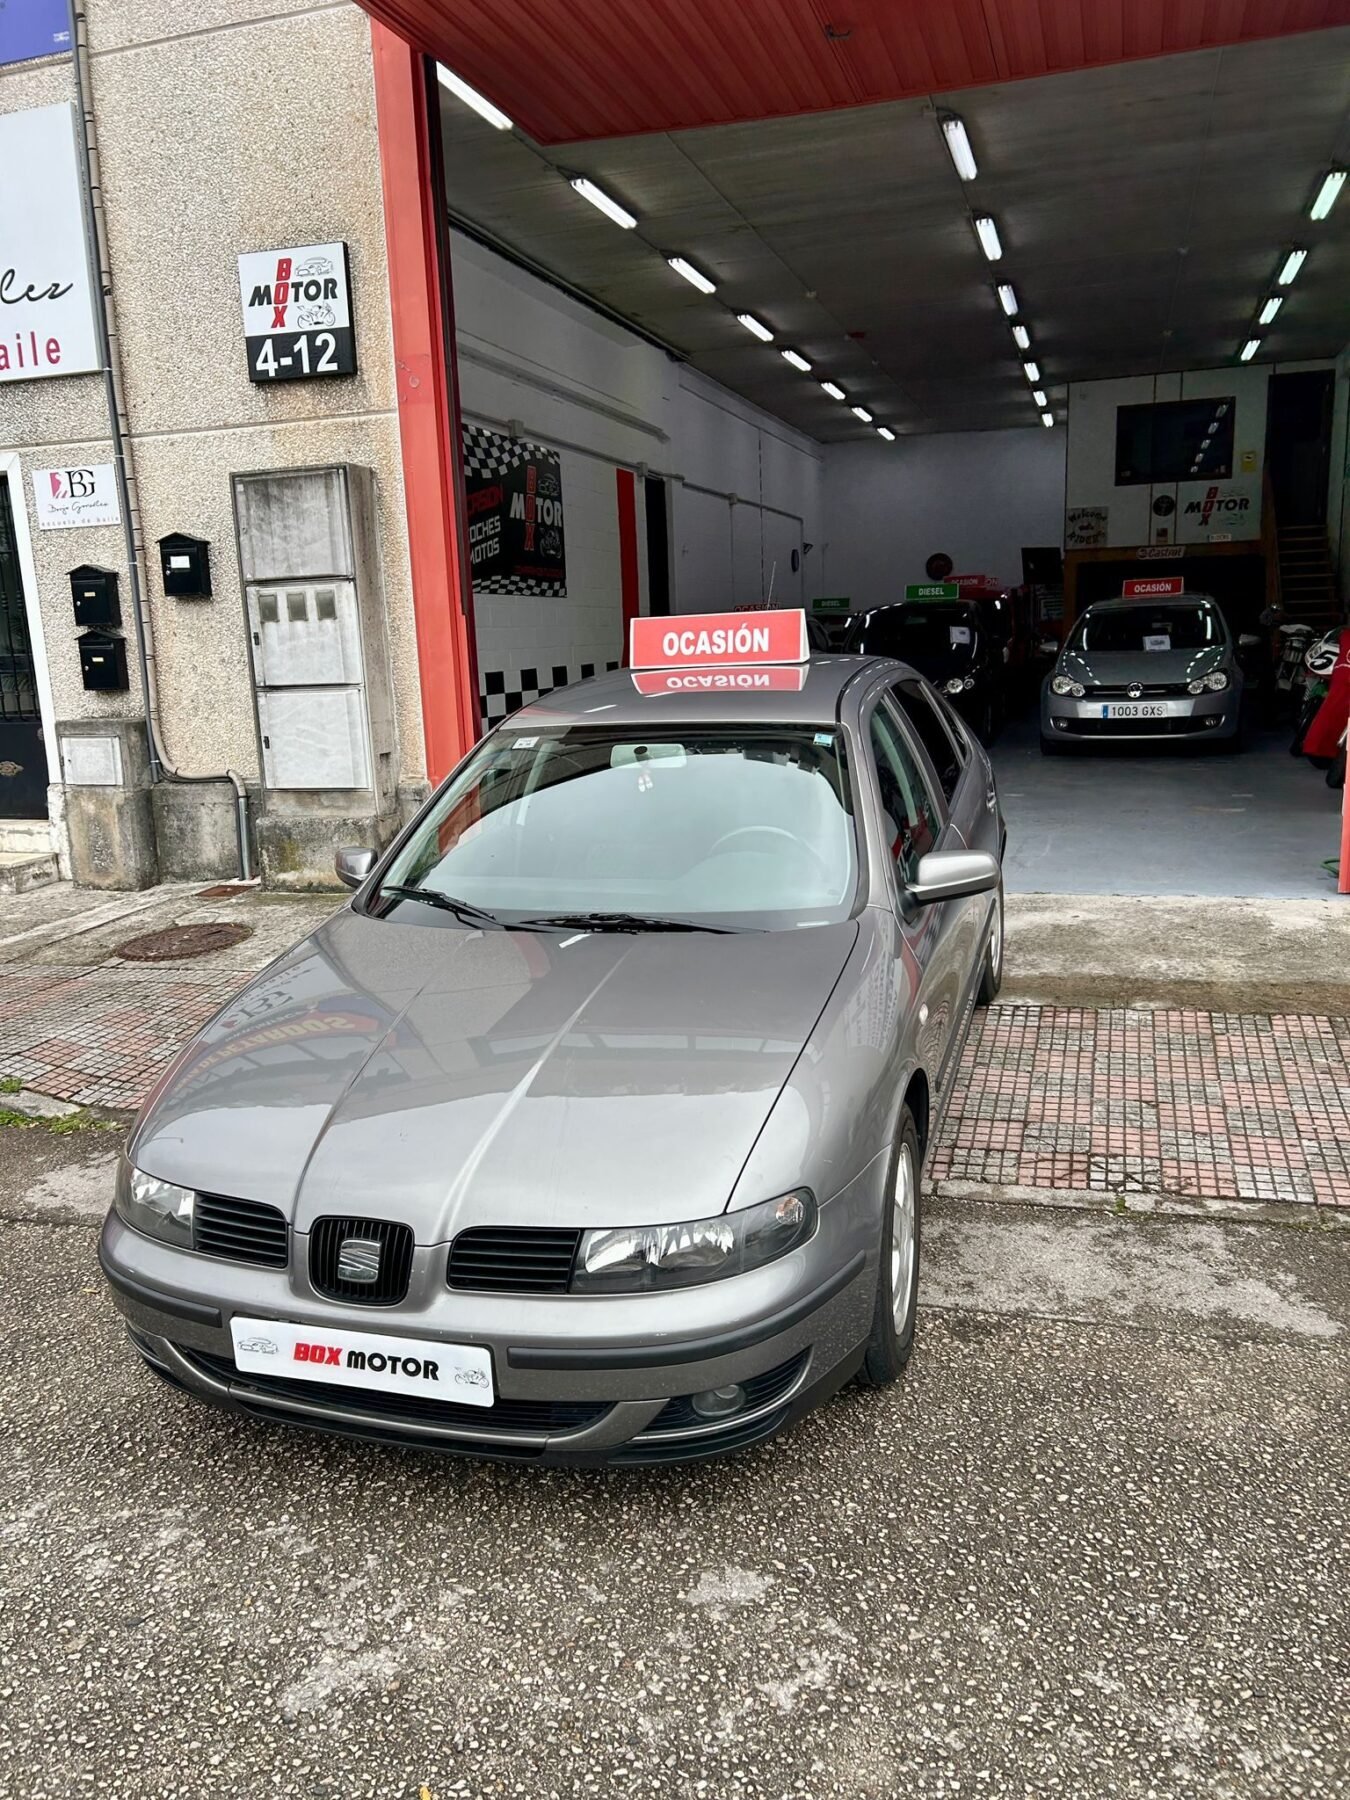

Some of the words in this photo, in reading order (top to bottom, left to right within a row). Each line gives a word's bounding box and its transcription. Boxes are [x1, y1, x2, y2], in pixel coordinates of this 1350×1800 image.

[248, 278, 338, 307] MOTOR
[271, 257, 292, 328] BOX
[255, 332, 338, 377] 4-12
[509, 492, 563, 528] MOTOR
[1184, 498, 1250, 514] MOTOR
[918, 587, 944, 596] DIESEL
[1134, 581, 1172, 594] OCASIÓN
[662, 623, 769, 657] OCASIÓN
[1112, 706, 1138, 717] 1003
[1142, 705, 1163, 716] GXS
[293, 1342, 343, 1366] BOX
[346, 1350, 440, 1381] MOTOR
